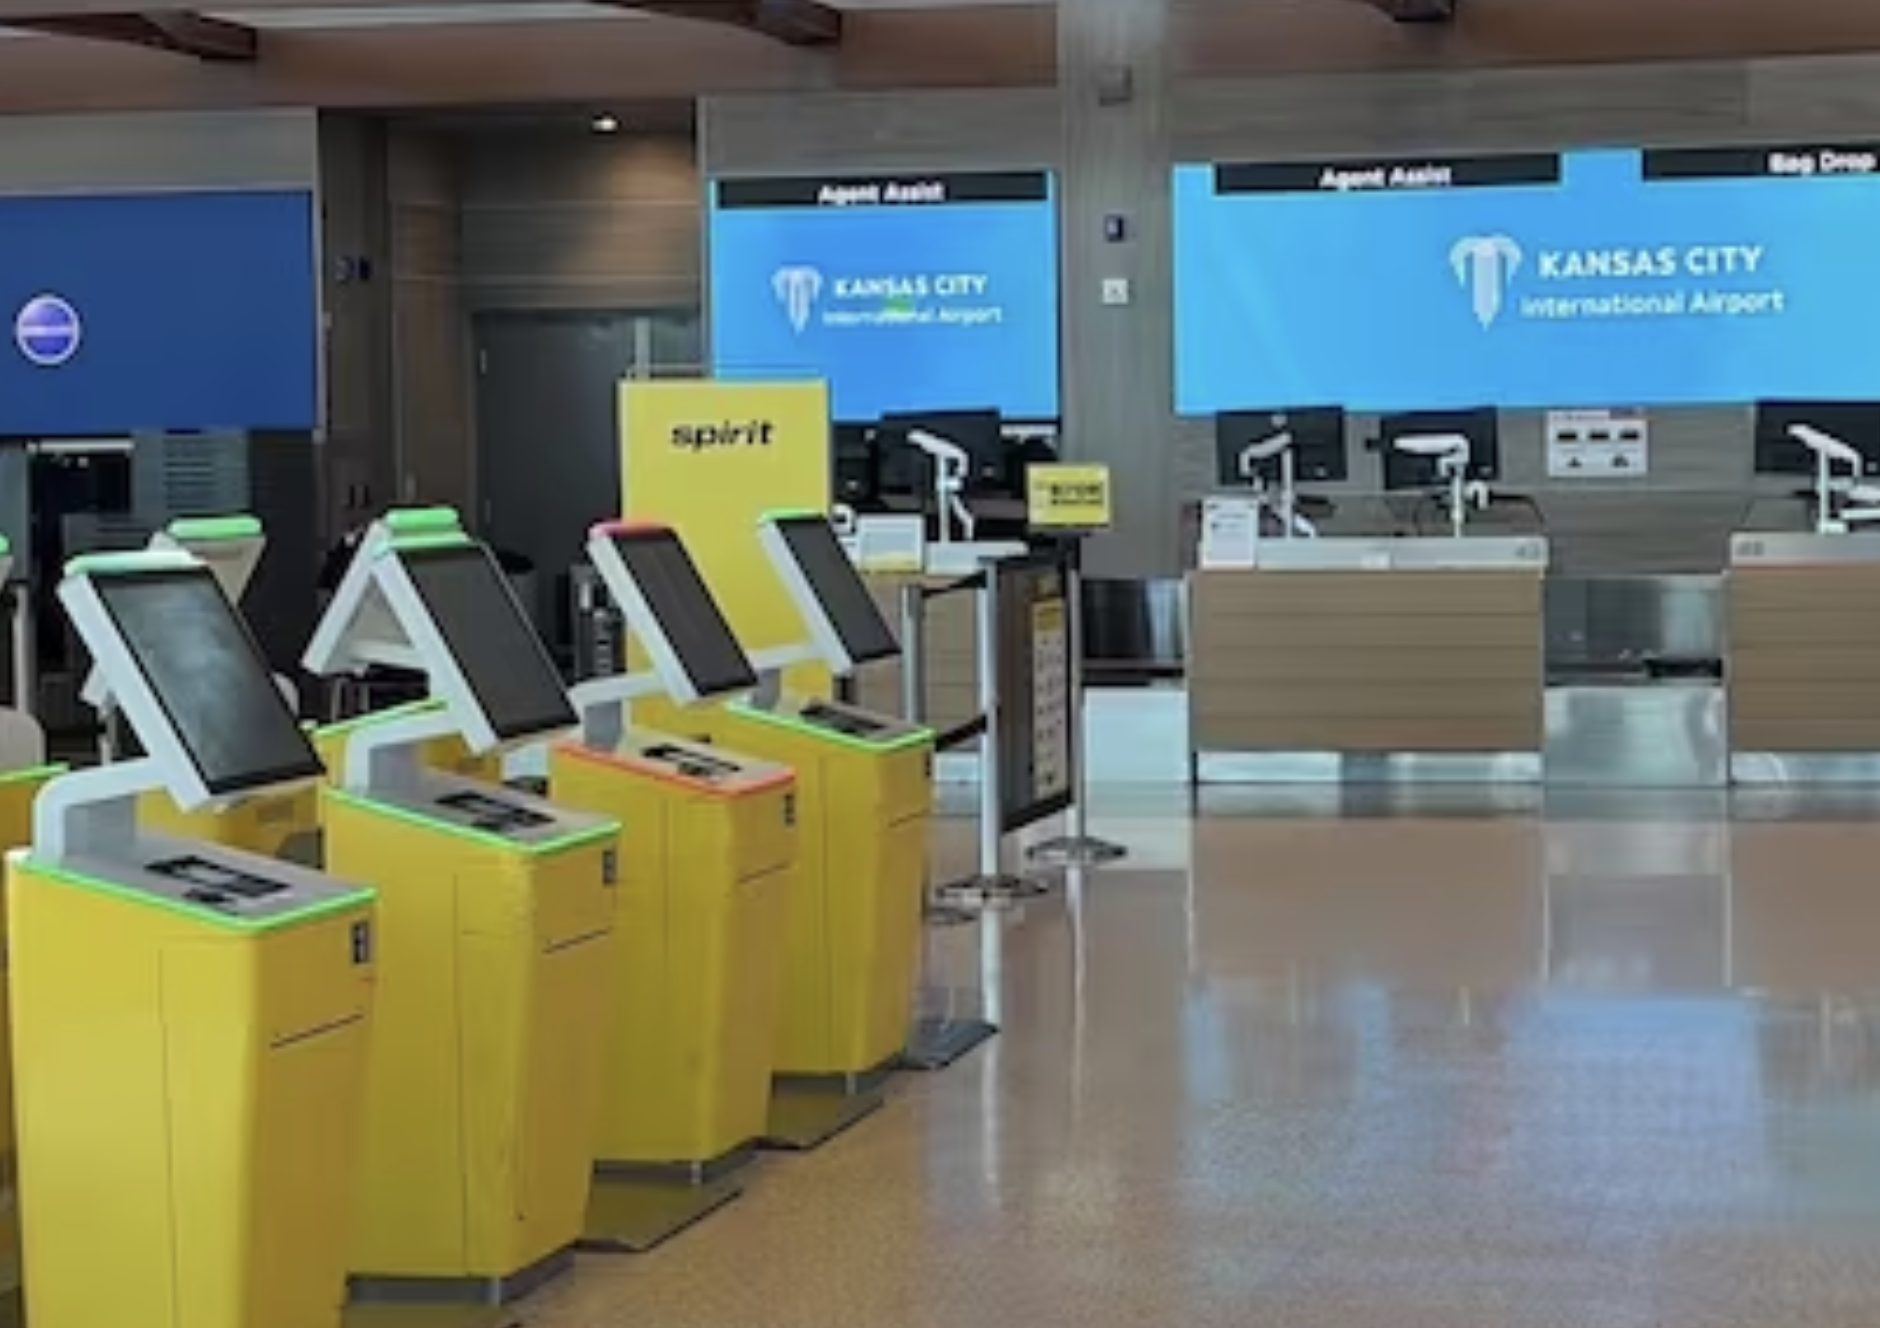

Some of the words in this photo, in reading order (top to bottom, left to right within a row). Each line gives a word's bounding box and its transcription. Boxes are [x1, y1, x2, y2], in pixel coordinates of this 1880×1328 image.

[1820, 149, 1877, 174] Drop
[1319, 164, 1386, 192] Agent
[1389, 162, 1452, 187] Assist
[818, 184, 880, 206] Agent
[1538, 246, 1677, 279] KANSAS
[1684, 244, 1765, 274] CITY
[834, 275, 928, 297] KANSAS
[933, 273, 988, 295] CITY
[1520, 291, 1685, 318] International
[1688, 287, 1784, 316] Airport
[671, 418, 774, 453] spirit
